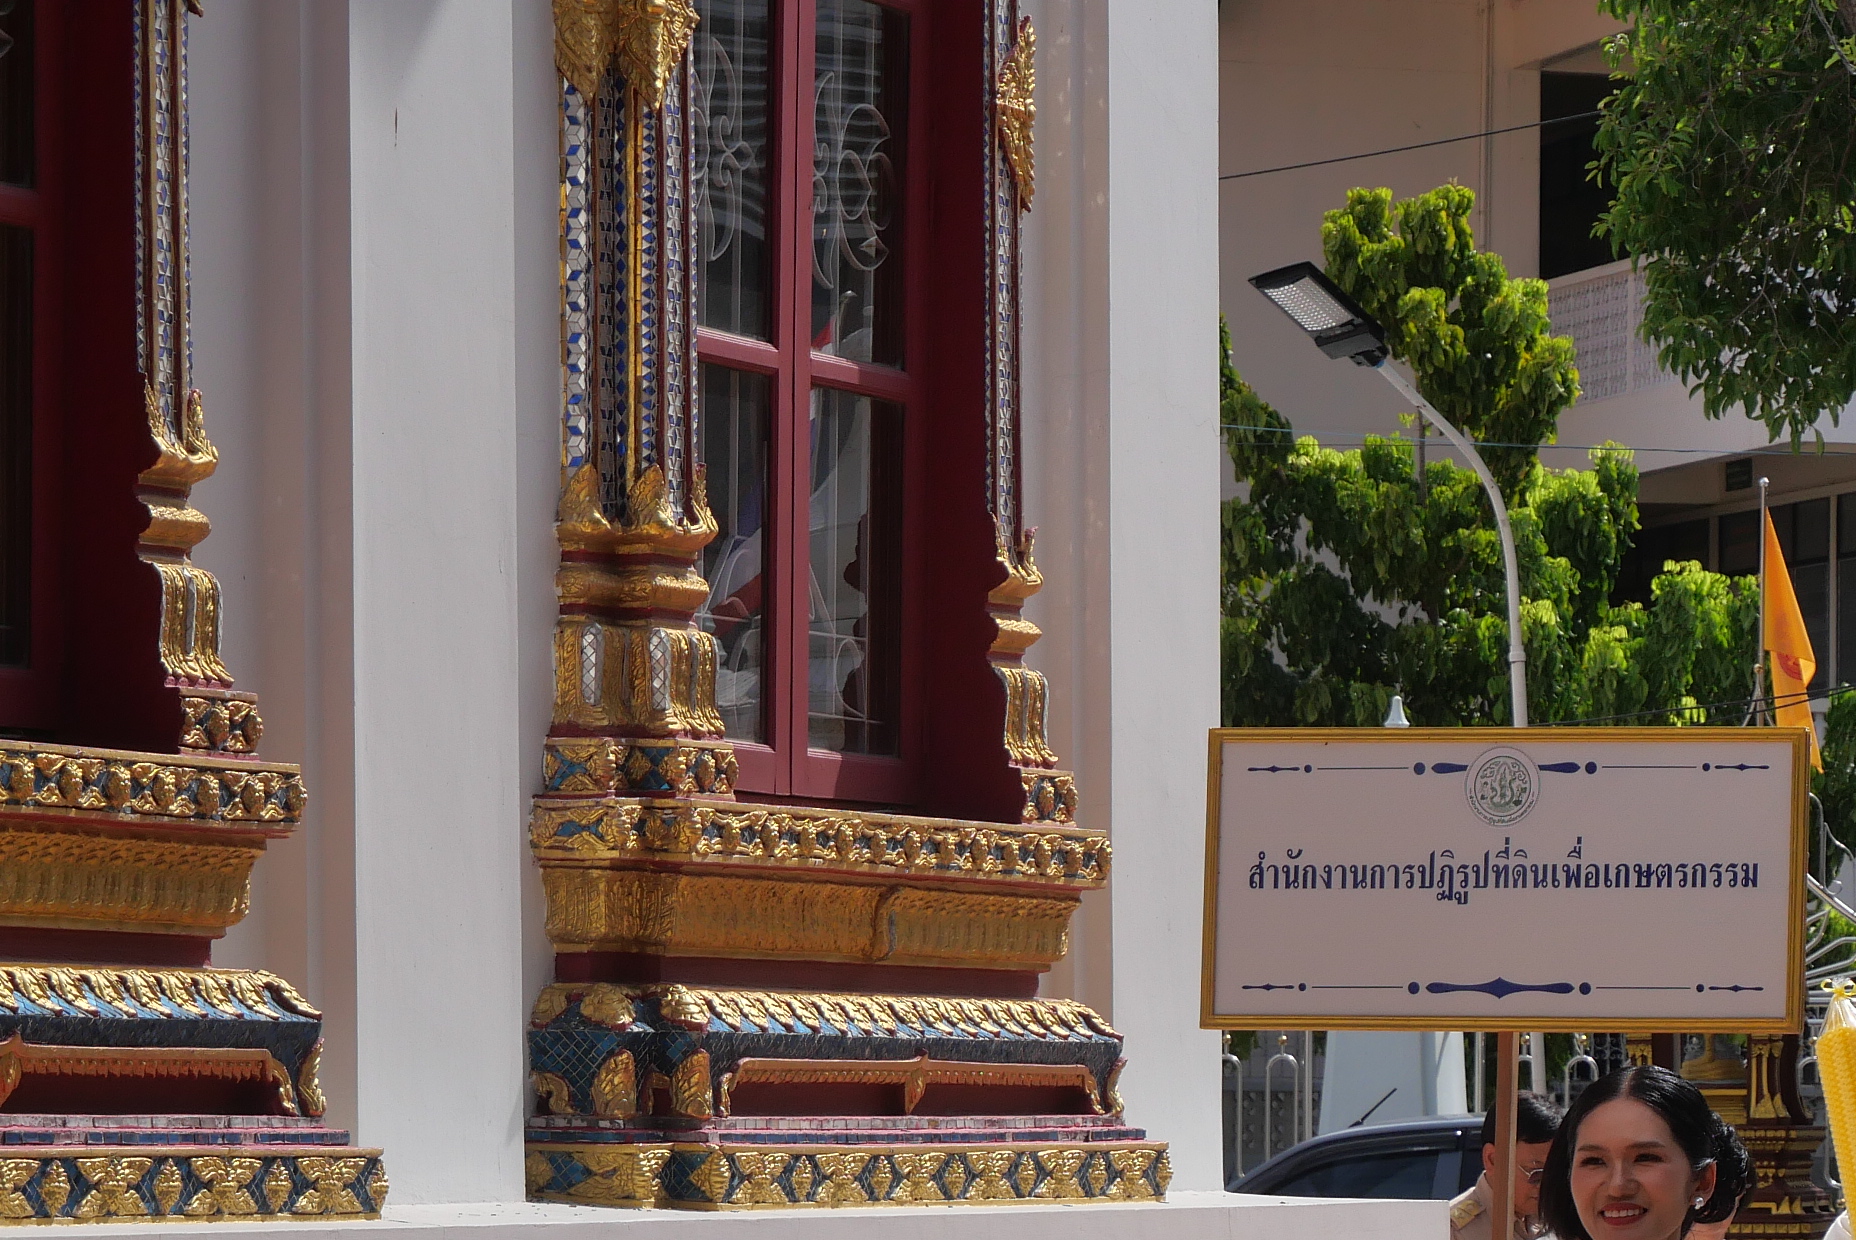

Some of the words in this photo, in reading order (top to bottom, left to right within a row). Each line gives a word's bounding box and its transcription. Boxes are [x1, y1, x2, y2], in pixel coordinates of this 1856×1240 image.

[1249, 836, 1759, 905] สำนักงานการปฏิรูปที่ดินเพื่อเกษตรกรรม
